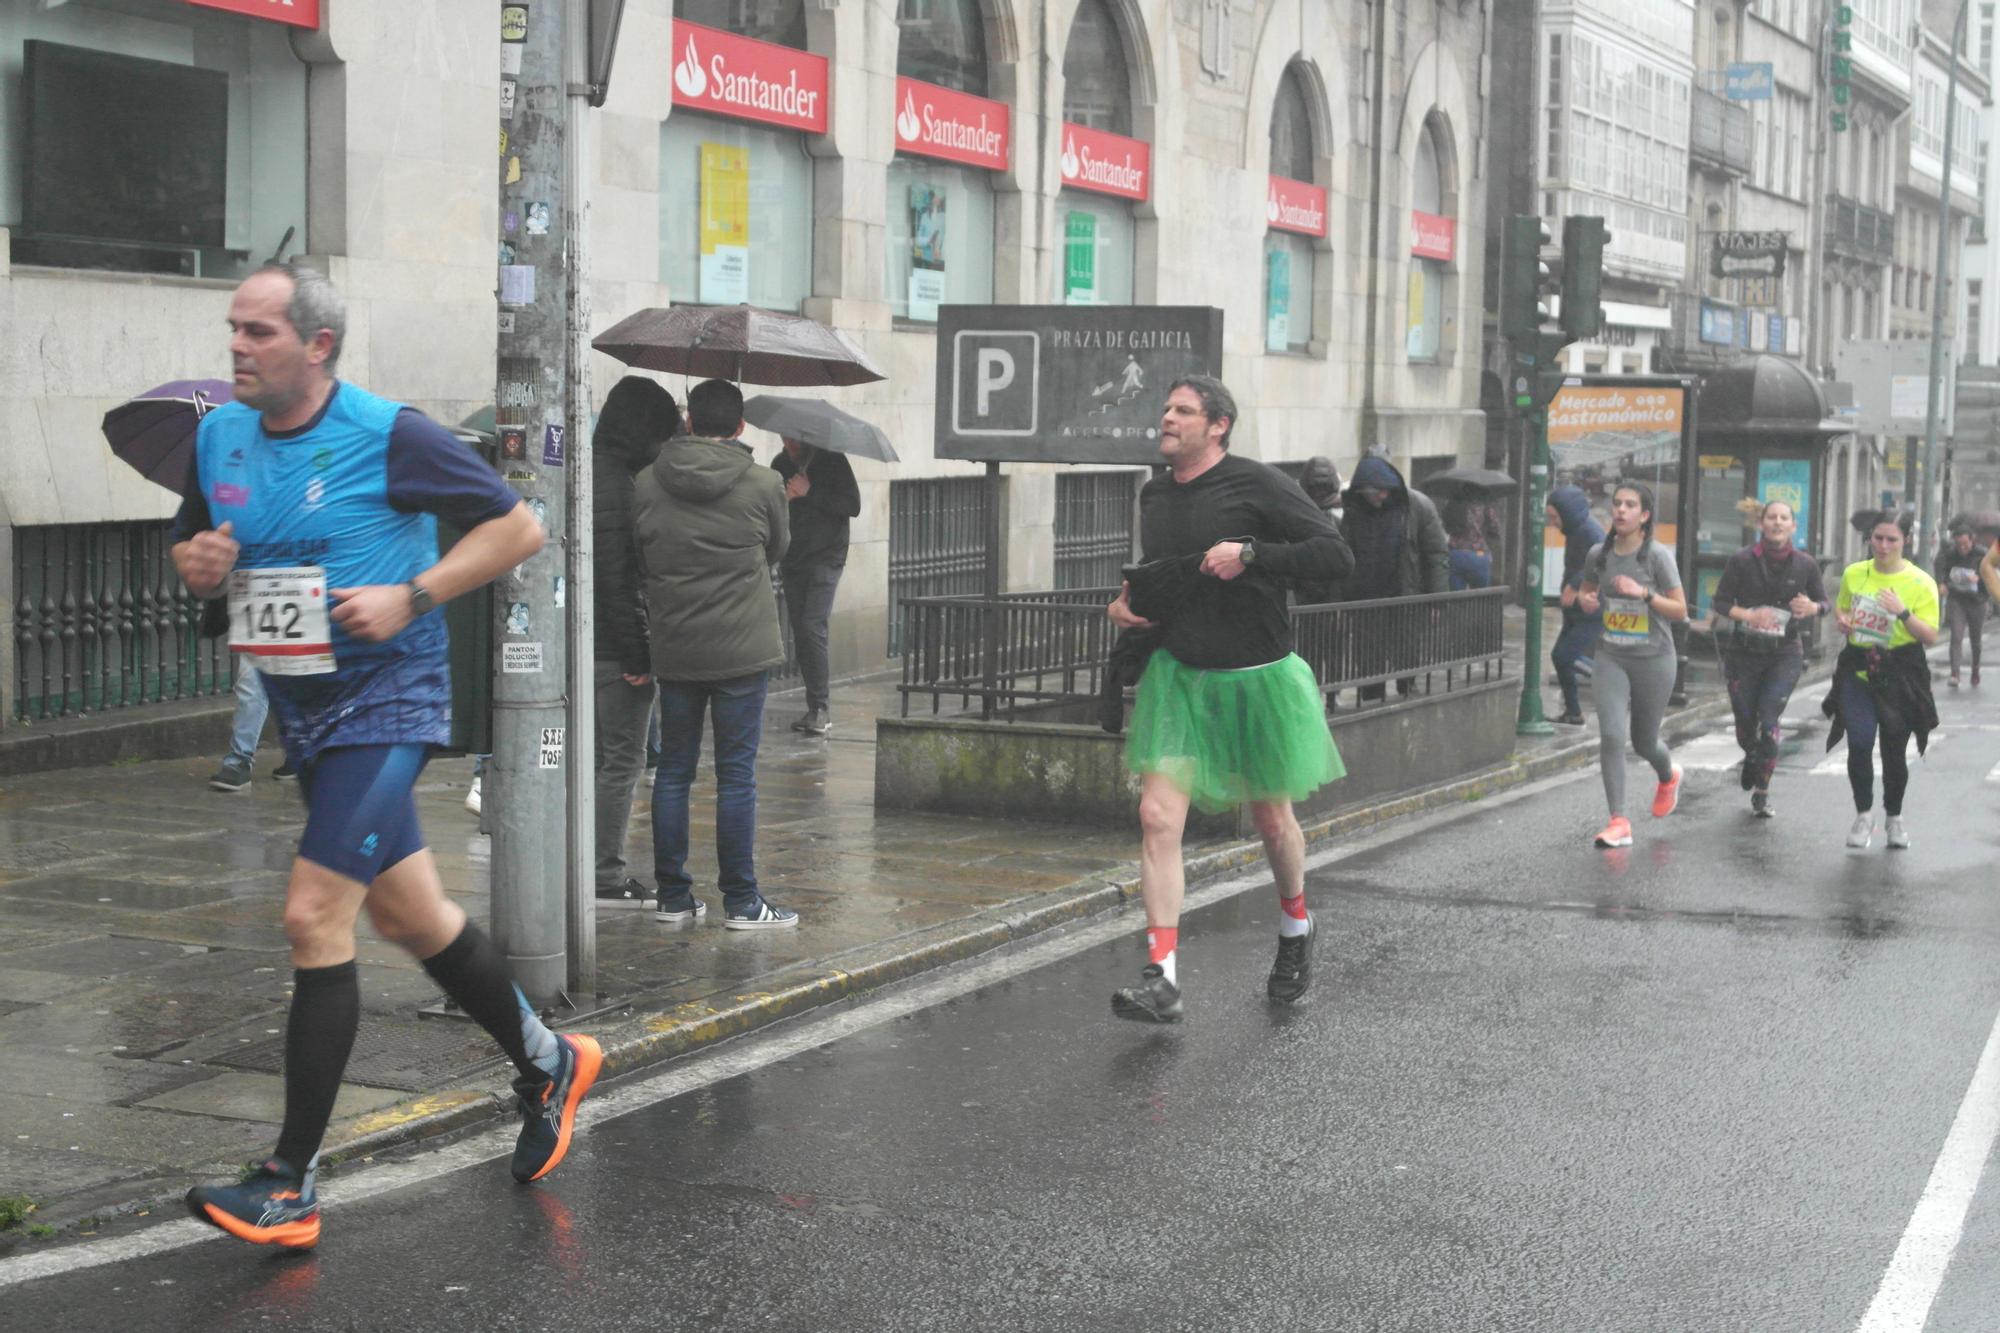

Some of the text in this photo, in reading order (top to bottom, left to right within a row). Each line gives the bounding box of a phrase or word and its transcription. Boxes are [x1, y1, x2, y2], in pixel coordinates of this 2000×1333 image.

[711, 54, 817, 119] Santander
[923, 103, 1002, 157] Santander
[1081, 145, 1143, 192] Santander
[1279, 194, 1323, 230] Santander
[1418, 223, 1451, 253] Santander
[1718, 231, 1781, 249] VIAJES
[1053, 330, 1192, 349] PRAZA DE GALICIA
[977, 347, 1016, 417] P
[1559, 392, 1627, 411] Mercado
[242, 602, 305, 640] 142
[1608, 611, 1640, 630] 427
